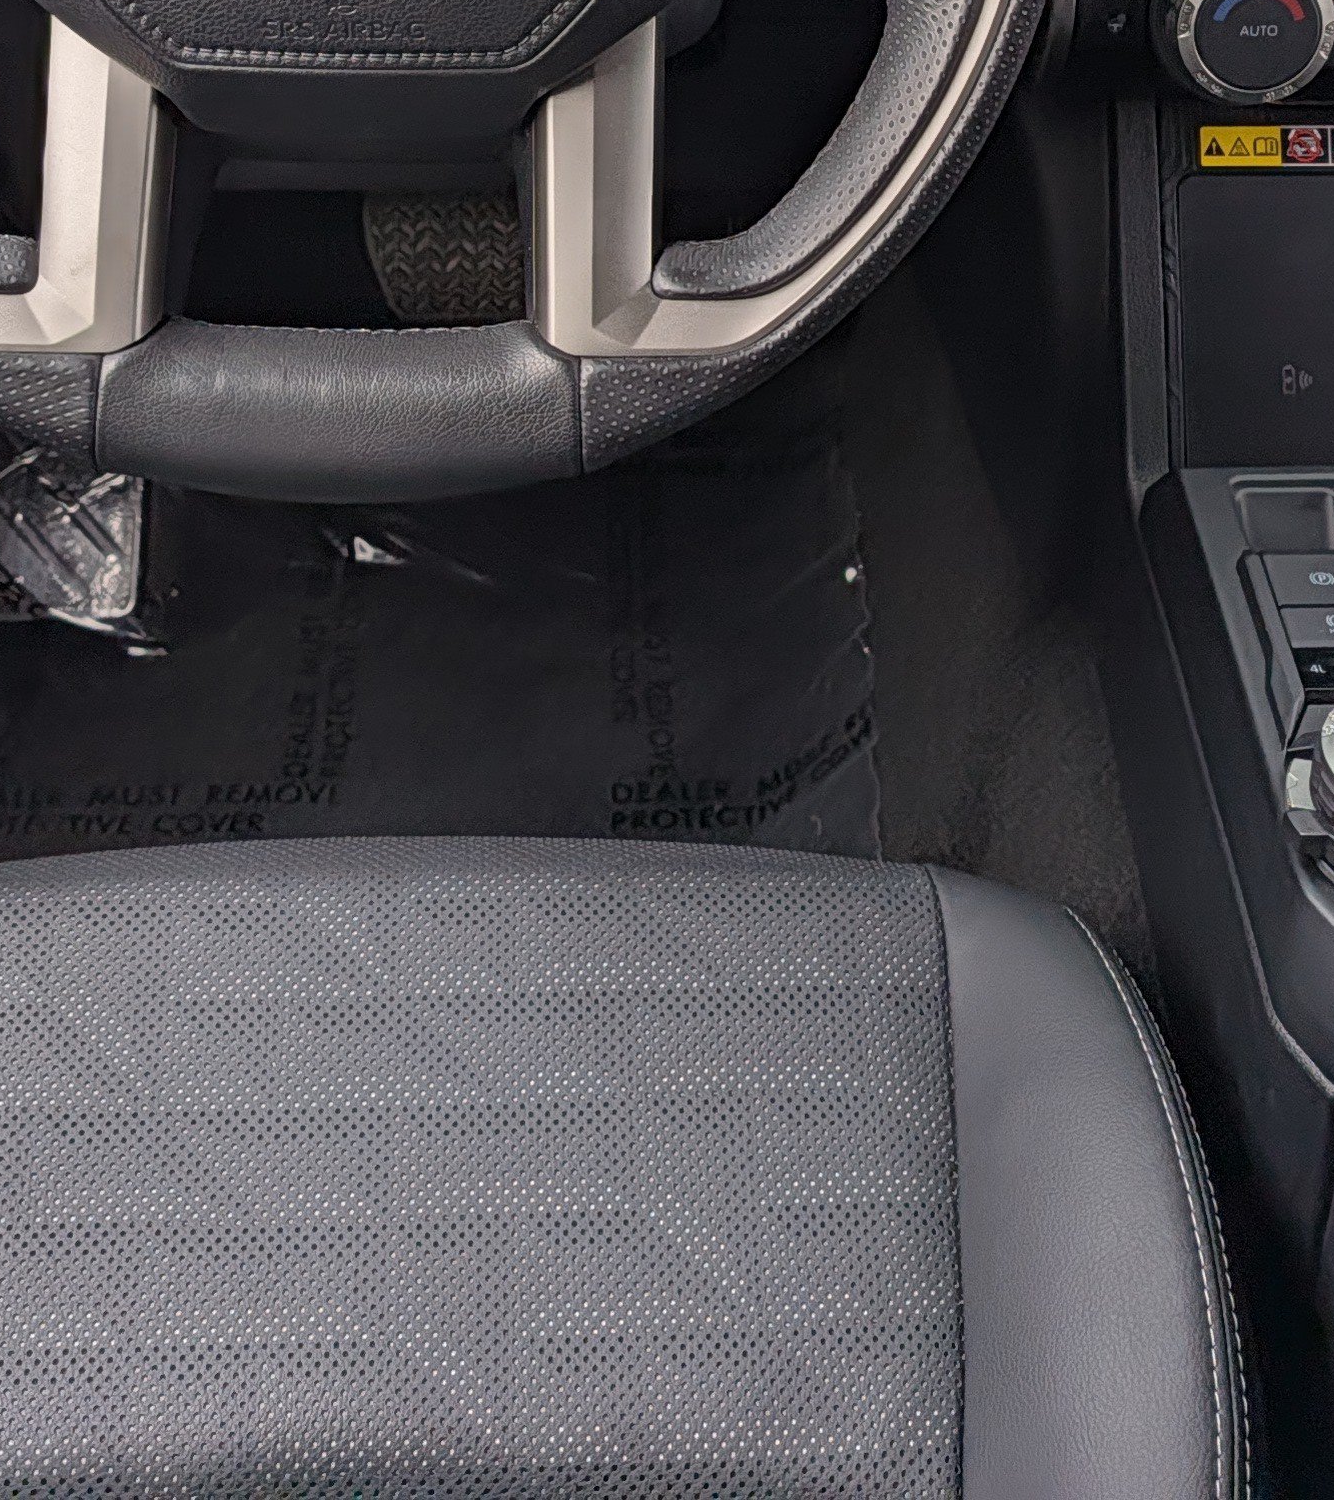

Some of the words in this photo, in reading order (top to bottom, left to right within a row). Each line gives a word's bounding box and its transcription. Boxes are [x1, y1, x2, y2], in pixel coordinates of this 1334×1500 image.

[265, 20, 316, 41] SRS
[323, 20, 427, 42] AIRBAG
[1239, 24, 1279, 38] AUTO
[1310, 664, 1327, 674] 4L
[86, 784, 179, 808] MUST
[610, 780, 730, 805] DEALER
[153, 812, 266, 837] COVER
